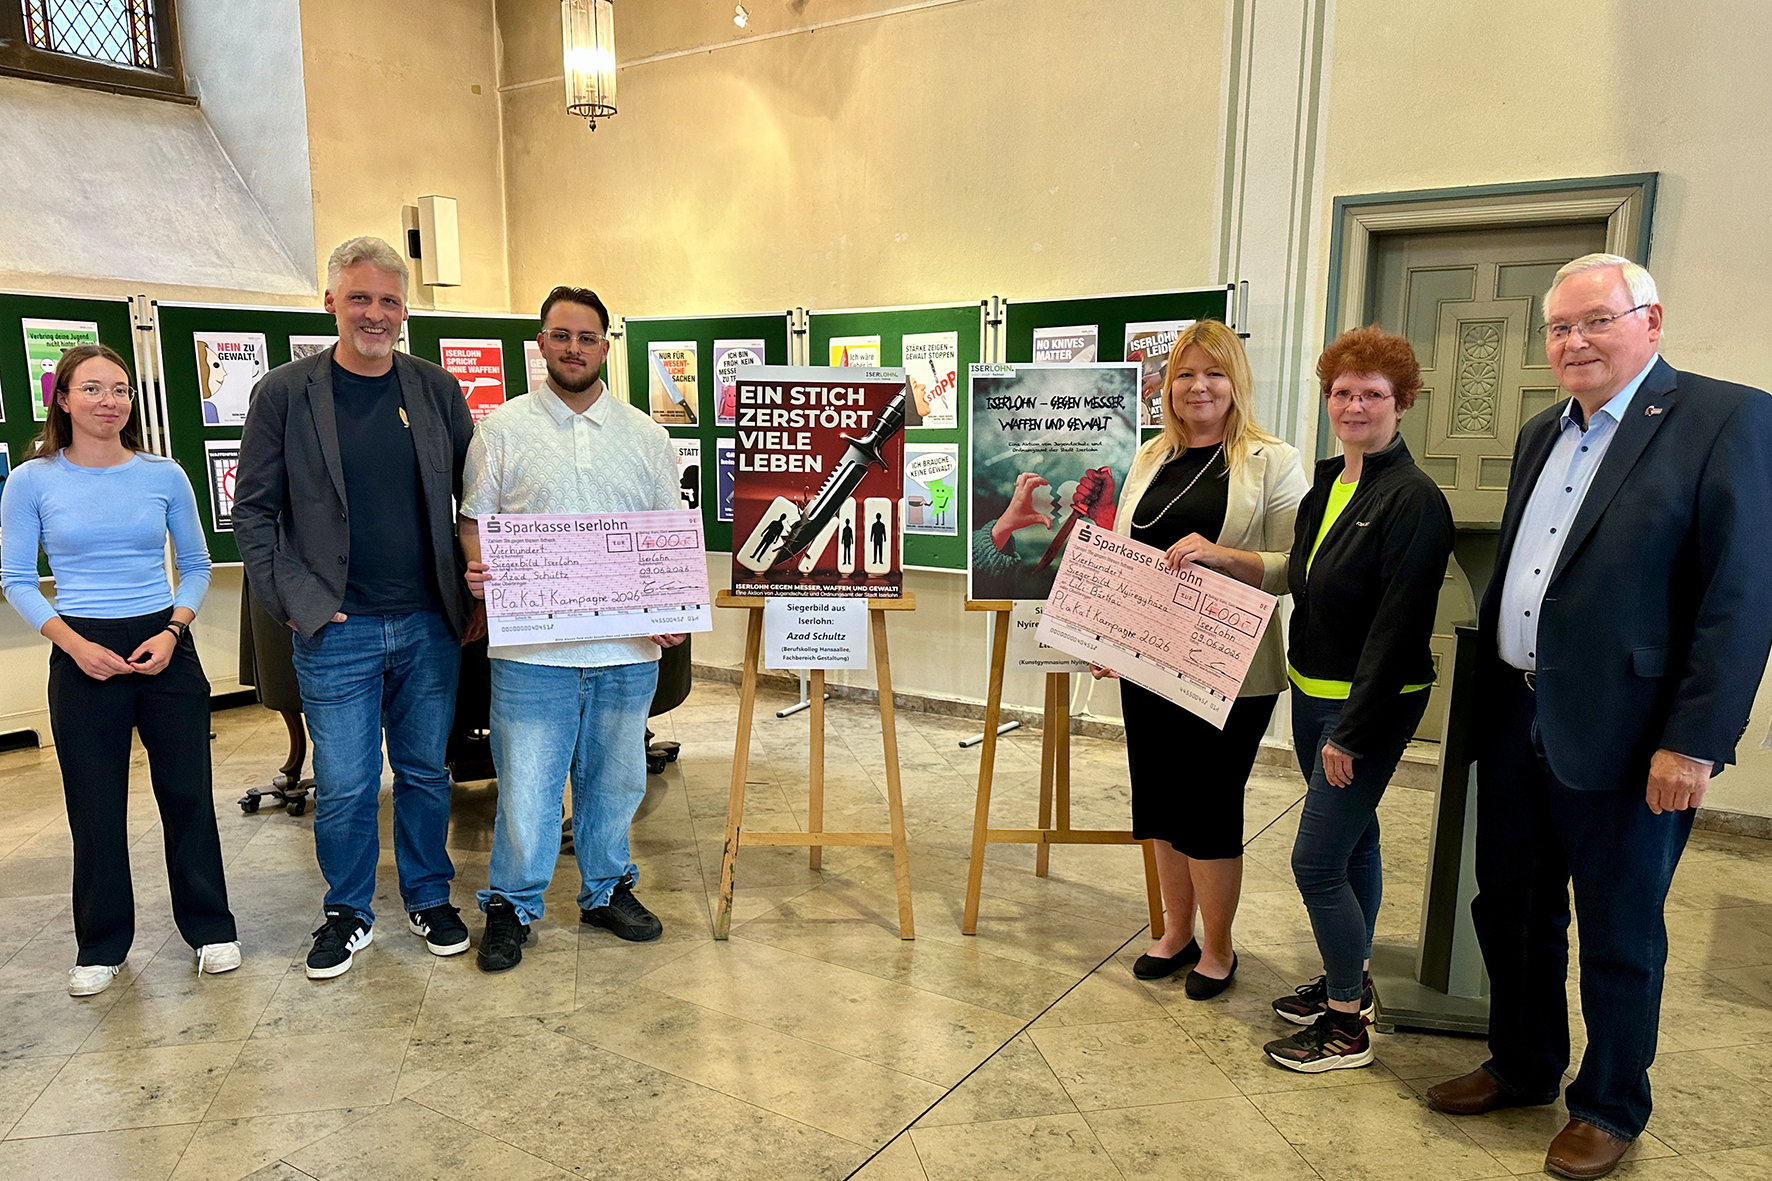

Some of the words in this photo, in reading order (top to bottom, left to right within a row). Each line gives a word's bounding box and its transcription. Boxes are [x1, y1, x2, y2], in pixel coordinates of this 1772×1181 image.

[70, 333, 89, 342] Jugend
[1036, 339, 1049, 350] NO
[1051, 337, 1085, 349] KNIVES
[1131, 330, 1178, 351] ISERLOHN
[217, 343, 241, 352] NEIN
[243, 344, 255, 352] ZU
[445, 349, 481, 358] ISERLOHN
[906, 344, 926, 352] STÄRKE
[218, 352, 255, 361] GEWALT!
[673, 350, 685, 359] FÜR
[928, 351, 955, 359] STOPPEN
[1036, 350, 1072, 361] MATTER
[446, 357, 477, 366] SPRICHT
[447, 366, 467, 374] OHNE
[468, 366, 500, 374] WAFFEN!
[926, 370, 956, 402] STOPP
[740, 385, 782, 405] EIN
[790, 387, 865, 406] STICH
[986, 395, 1037, 411] ISERLOHN
[1050, 395, 1081, 410] GEGEN
[739, 405, 873, 429] ZERSTÖRT
[998, 417, 1043, 432] WAFFEN
[1045, 418, 1065, 430] UND
[1067, 416, 1112, 431] GEWALT
[738, 431, 811, 450] VIELE
[679, 448, 699, 456] STATT
[739, 453, 823, 473] LEBEN
[923, 456, 949, 467] BRAUCHE
[910, 469, 927, 477] KEINE
[928, 464, 952, 475] GEWALT!
[504, 521, 571, 535] Sparkasse
[574, 519, 628, 532] Iserlohn
[489, 544, 545, 554] Vierhundert
[491, 558, 539, 570] Siegerbild
[544, 557, 580, 567] Iserlohn
[639, 553, 670, 562] Iserlohn
[1072, 550, 1123, 577] Vierhundert
[1093, 534, 1153, 566] Sparkasse
[1154, 558, 1203, 587] Iserlohn
[499, 571, 527, 581] Azad
[533, 571, 569, 580] Schultz
[1067, 563, 1110, 588] Siegerbild
[550, 589, 608, 607] Kampagne
[611, 590, 640, 602] 2026
[787, 603, 829, 613] Siegerbild
[798, 617, 834, 625] Iserlohn:
[1197, 616, 1236, 642] Iserlohn
[786, 632, 810, 640] Azad
[812, 632, 847, 640] Schultz
[1139, 630, 1172, 652] 2026
